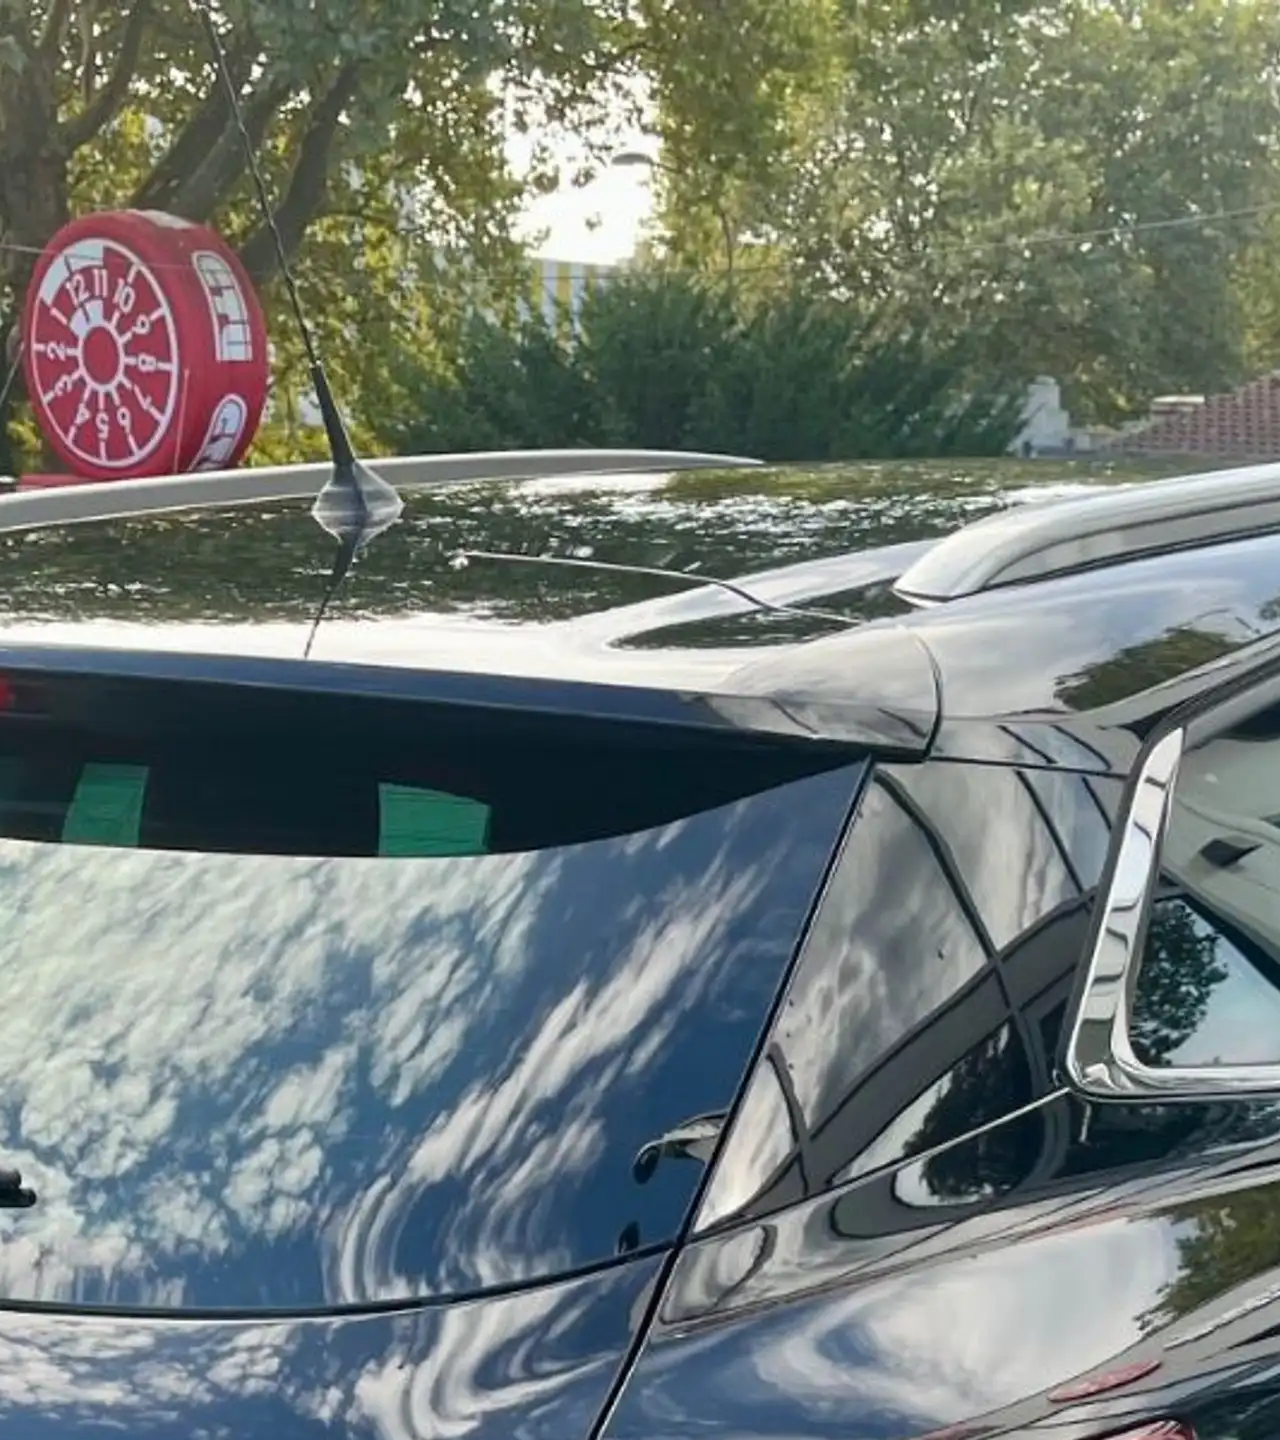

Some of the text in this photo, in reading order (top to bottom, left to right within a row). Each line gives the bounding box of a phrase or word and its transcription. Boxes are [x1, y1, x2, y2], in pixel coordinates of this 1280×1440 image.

[66, 276, 90, 307] 12
[93, 268, 109, 297] 11
[113, 278, 136, 313] 10
[47, 342, 67, 361] 2
[138, 354, 157, 373] 8
[54, 374, 73, 397] 3
[75, 402, 91, 425] 4
[95, 412, 110, 439] 5
